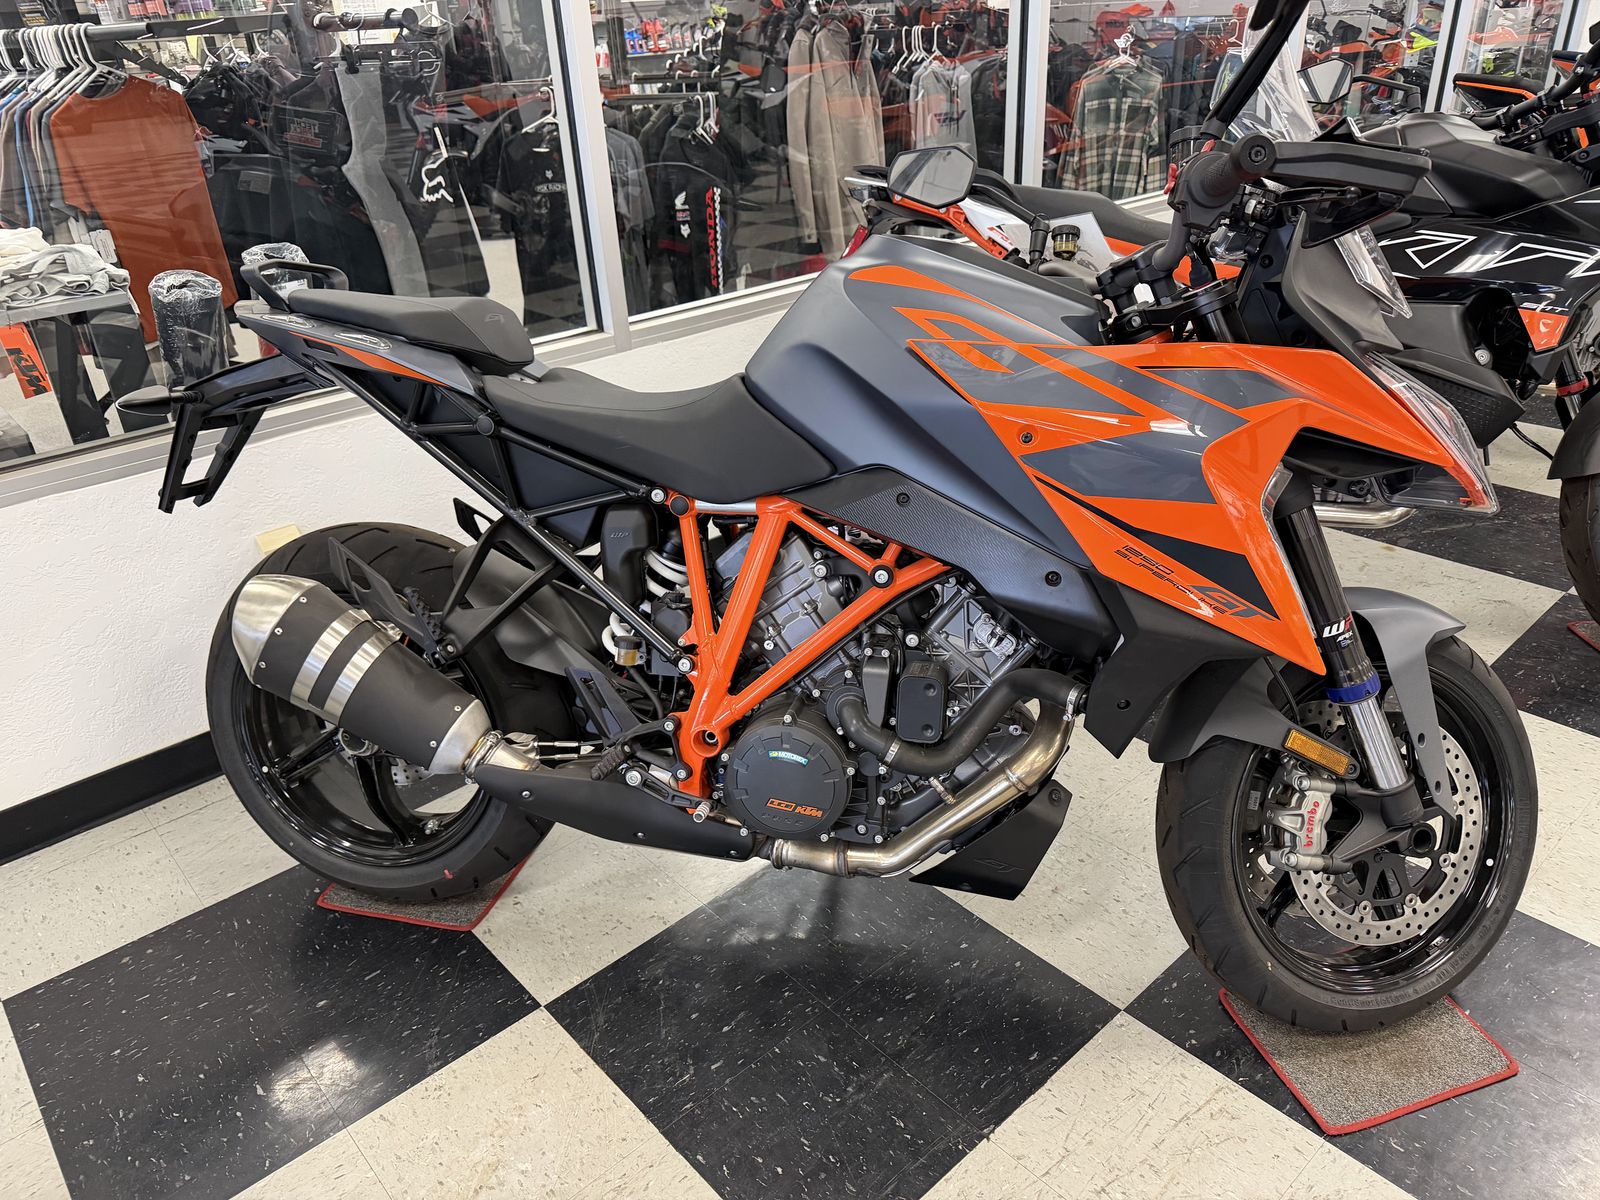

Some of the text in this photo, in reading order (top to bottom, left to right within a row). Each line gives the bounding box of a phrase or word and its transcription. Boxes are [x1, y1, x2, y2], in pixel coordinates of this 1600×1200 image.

[706, 186, 718, 287] HONDA
[1187, 584, 1276, 622] GT
[795, 805, 823, 817] KTM
[1303, 800, 1320, 848] brembo
